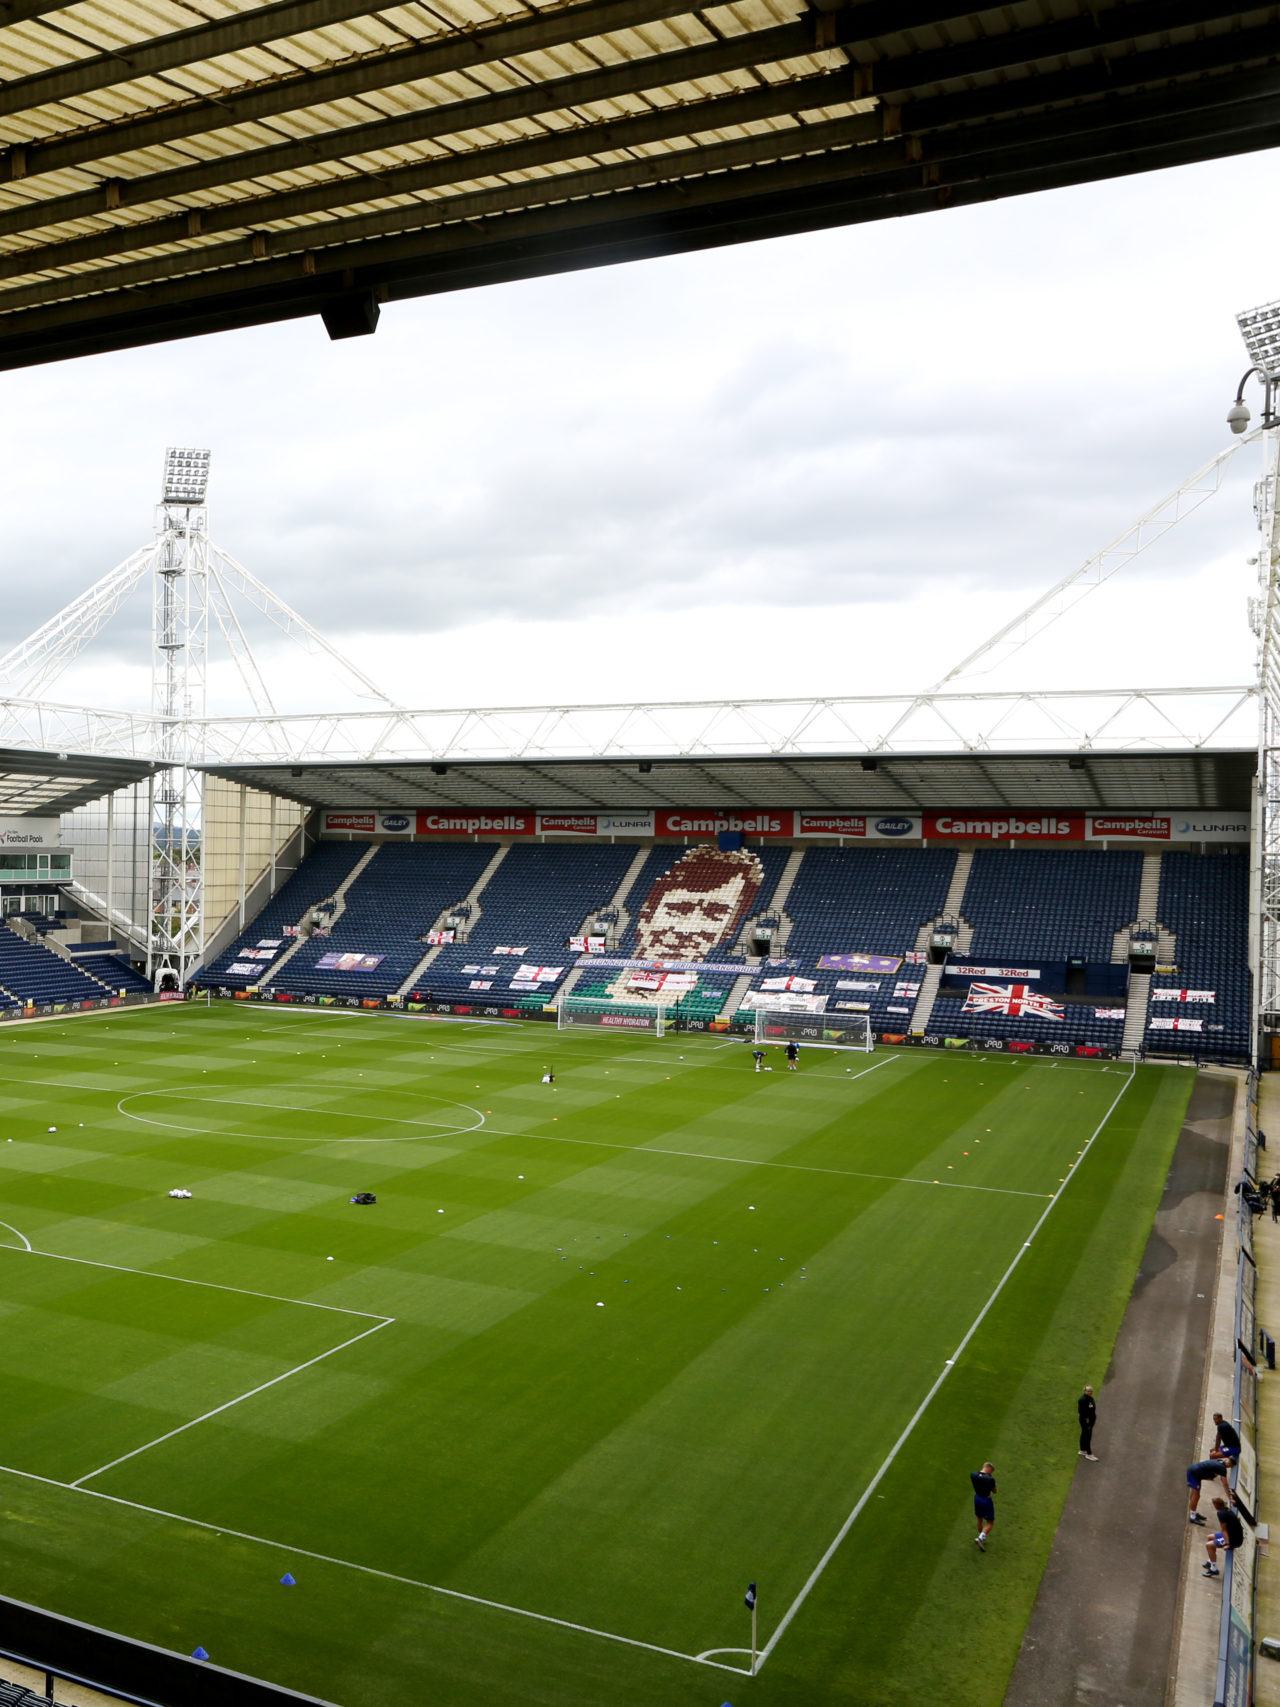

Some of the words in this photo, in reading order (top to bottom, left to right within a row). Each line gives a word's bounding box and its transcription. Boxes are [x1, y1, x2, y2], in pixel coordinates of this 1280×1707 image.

[327, 816, 374, 825] Campbells
[426, 815, 526, 833] Campbells
[542, 817, 595, 827] Campbells
[666, 815, 782, 833] Campbells
[802, 818, 865, 829] Campbells
[877, 822, 910, 830] BAILEY
[1094, 820, 1168, 831] Campbells
[935, 817, 1071, 838] Campbells
[956, 966, 986, 975] 32Red
[998, 969, 1029, 977] 32Red
[1012, 998, 1040, 1008] NORTH
